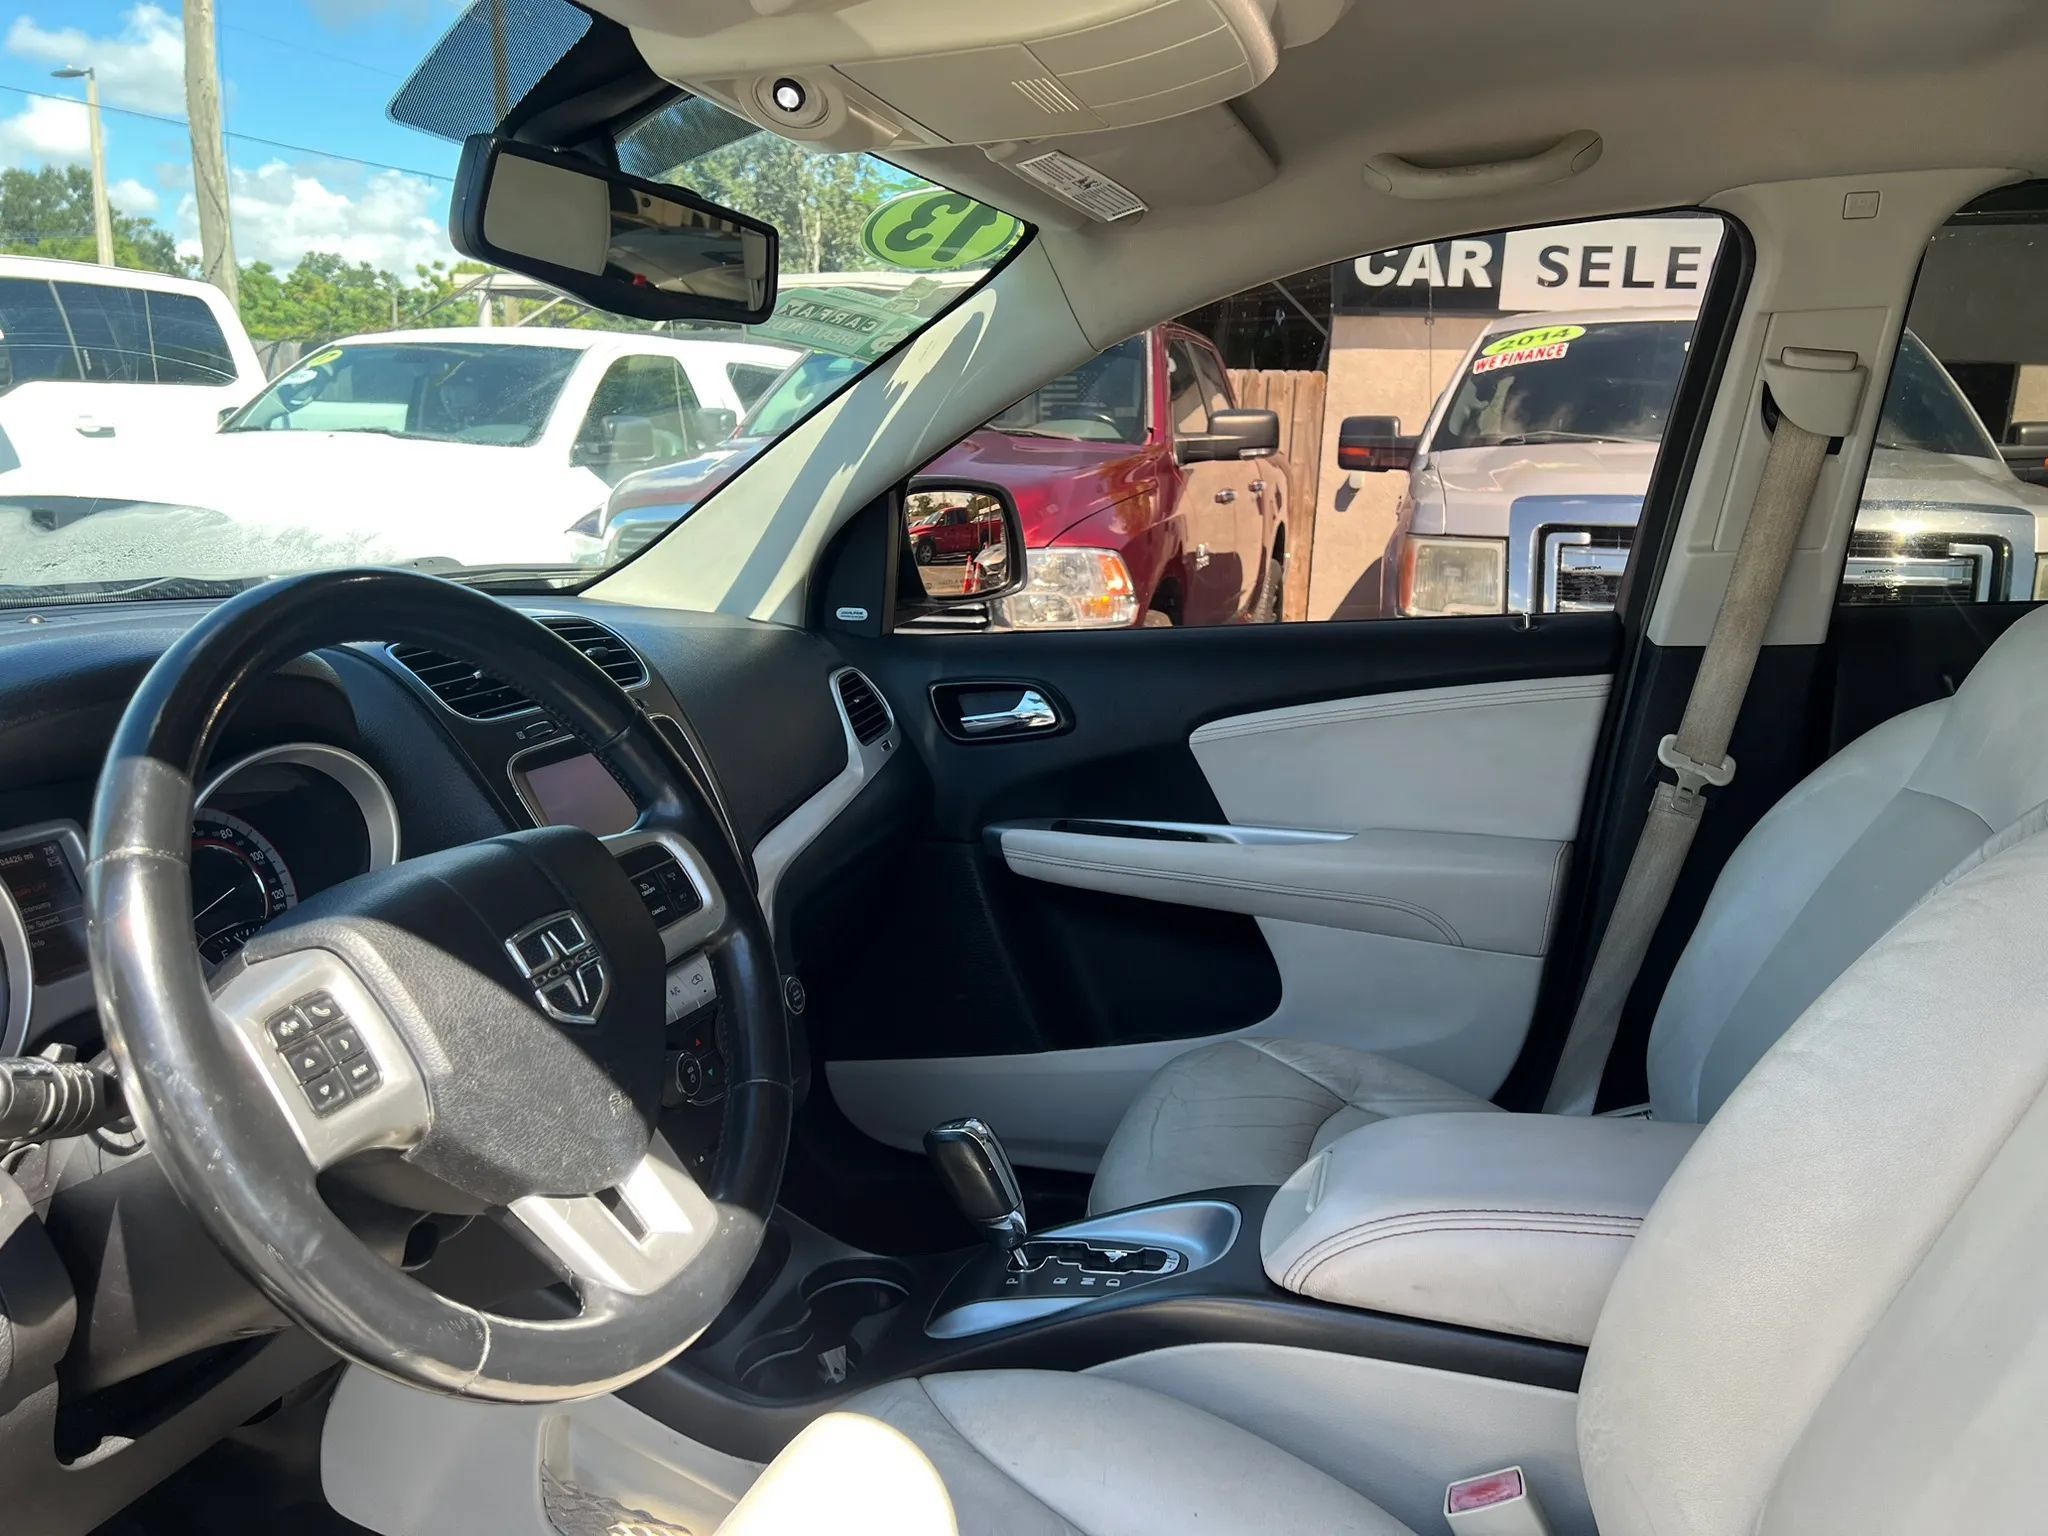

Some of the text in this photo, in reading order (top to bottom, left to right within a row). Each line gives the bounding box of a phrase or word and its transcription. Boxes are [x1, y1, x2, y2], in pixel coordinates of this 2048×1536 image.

[1354, 239, 1702, 290] CAR SELE
[1496, 327, 1571, 354] 2014
[1474, 341, 1566, 373] WE FINANCE
[219, 827, 233, 840] 80
[249, 850, 265, 863] 100
[270, 888, 285, 900] 120
[531, 945, 600, 989] DODGE
[1006, 1277, 1019, 1285] P
[1053, 1276, 1068, 1286] R
[1105, 1278, 1121, 1288] D
